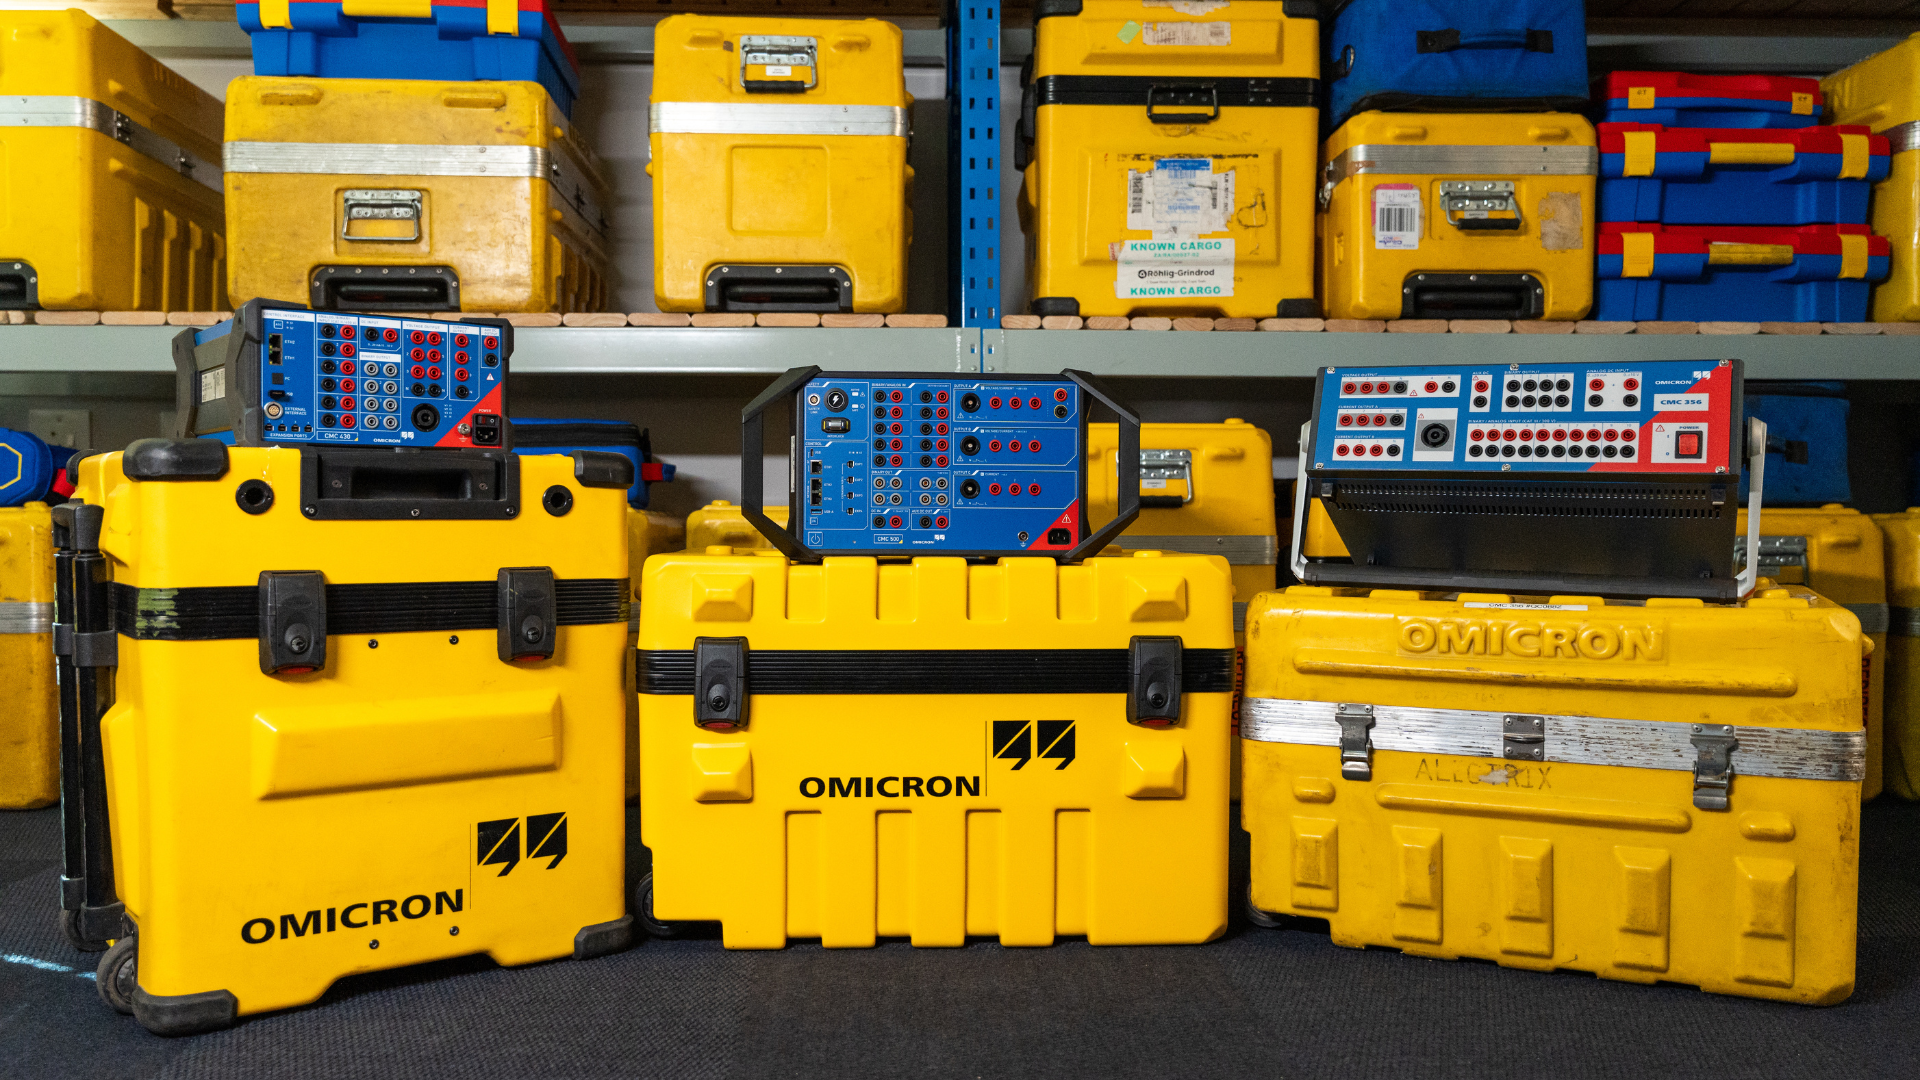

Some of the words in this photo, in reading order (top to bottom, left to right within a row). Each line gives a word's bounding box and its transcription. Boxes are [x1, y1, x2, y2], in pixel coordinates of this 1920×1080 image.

[1130, 242, 1175, 251] KNOWN
[1180, 241, 1222, 250] CARGO
[1148, 269, 1215, 278] Röhlig-Grindrod
[1130, 287, 1175, 296] KNOWN
[1180, 286, 1221, 294] CARGO
[1400, 621, 1664, 661] OMICRON
[799, 776, 980, 798] OMICRON
[241, 888, 463, 944] OMICRON
